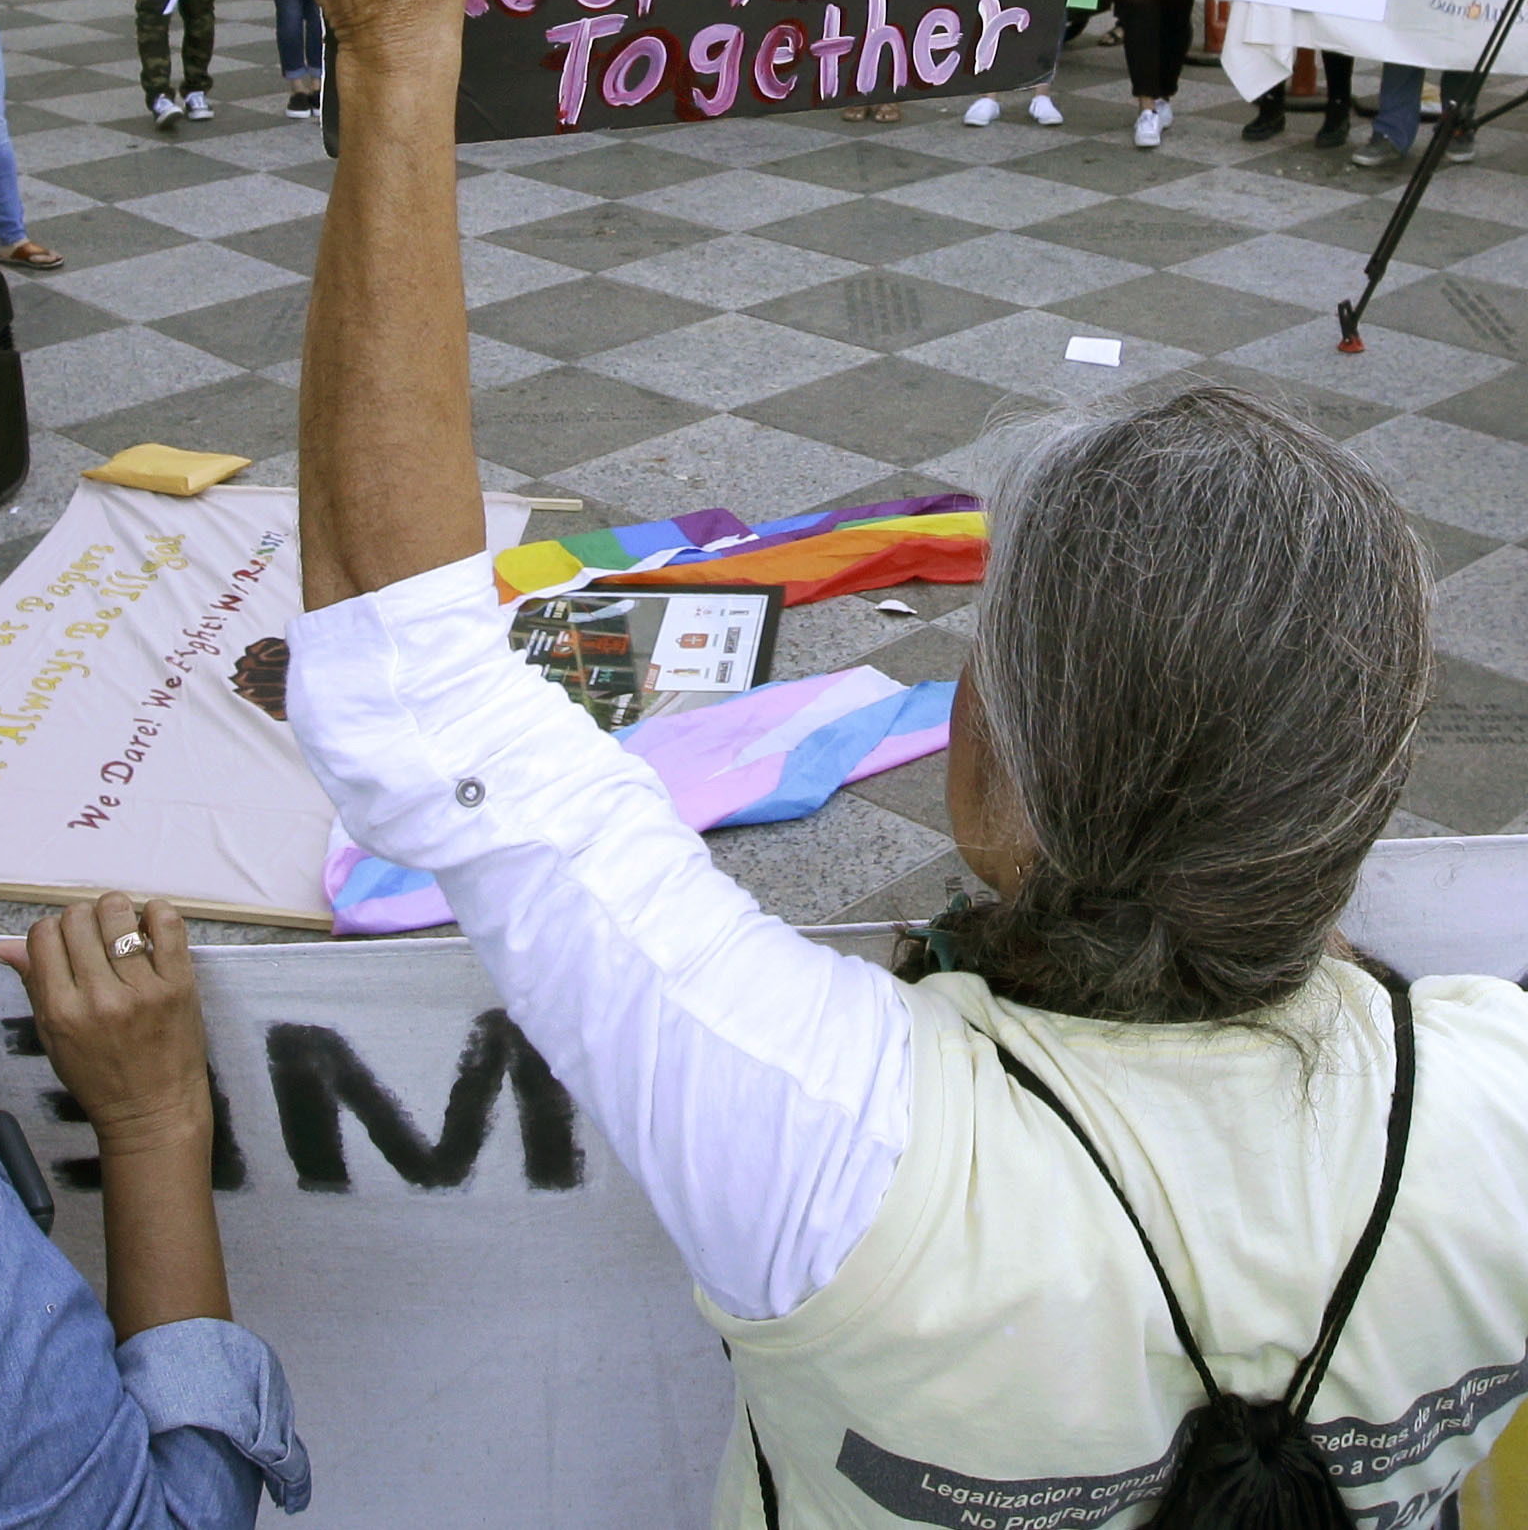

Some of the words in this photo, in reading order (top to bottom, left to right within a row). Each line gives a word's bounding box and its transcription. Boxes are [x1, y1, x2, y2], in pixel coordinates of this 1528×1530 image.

[16, 543, 115, 614] Papers
[65, 603, 123, 640] Be
[67, 793, 121, 831] We
[101, 717, 162, 786] Dare!
[141, 674, 183, 711] We
[165, 615, 228, 674] Fight!
[1310, 1427, 1409, 1453] Redadas
[1414, 1406, 1431, 1433] de
[1435, 1396, 1455, 1412] la
[921, 1472, 1082, 1510] Legalizacion
